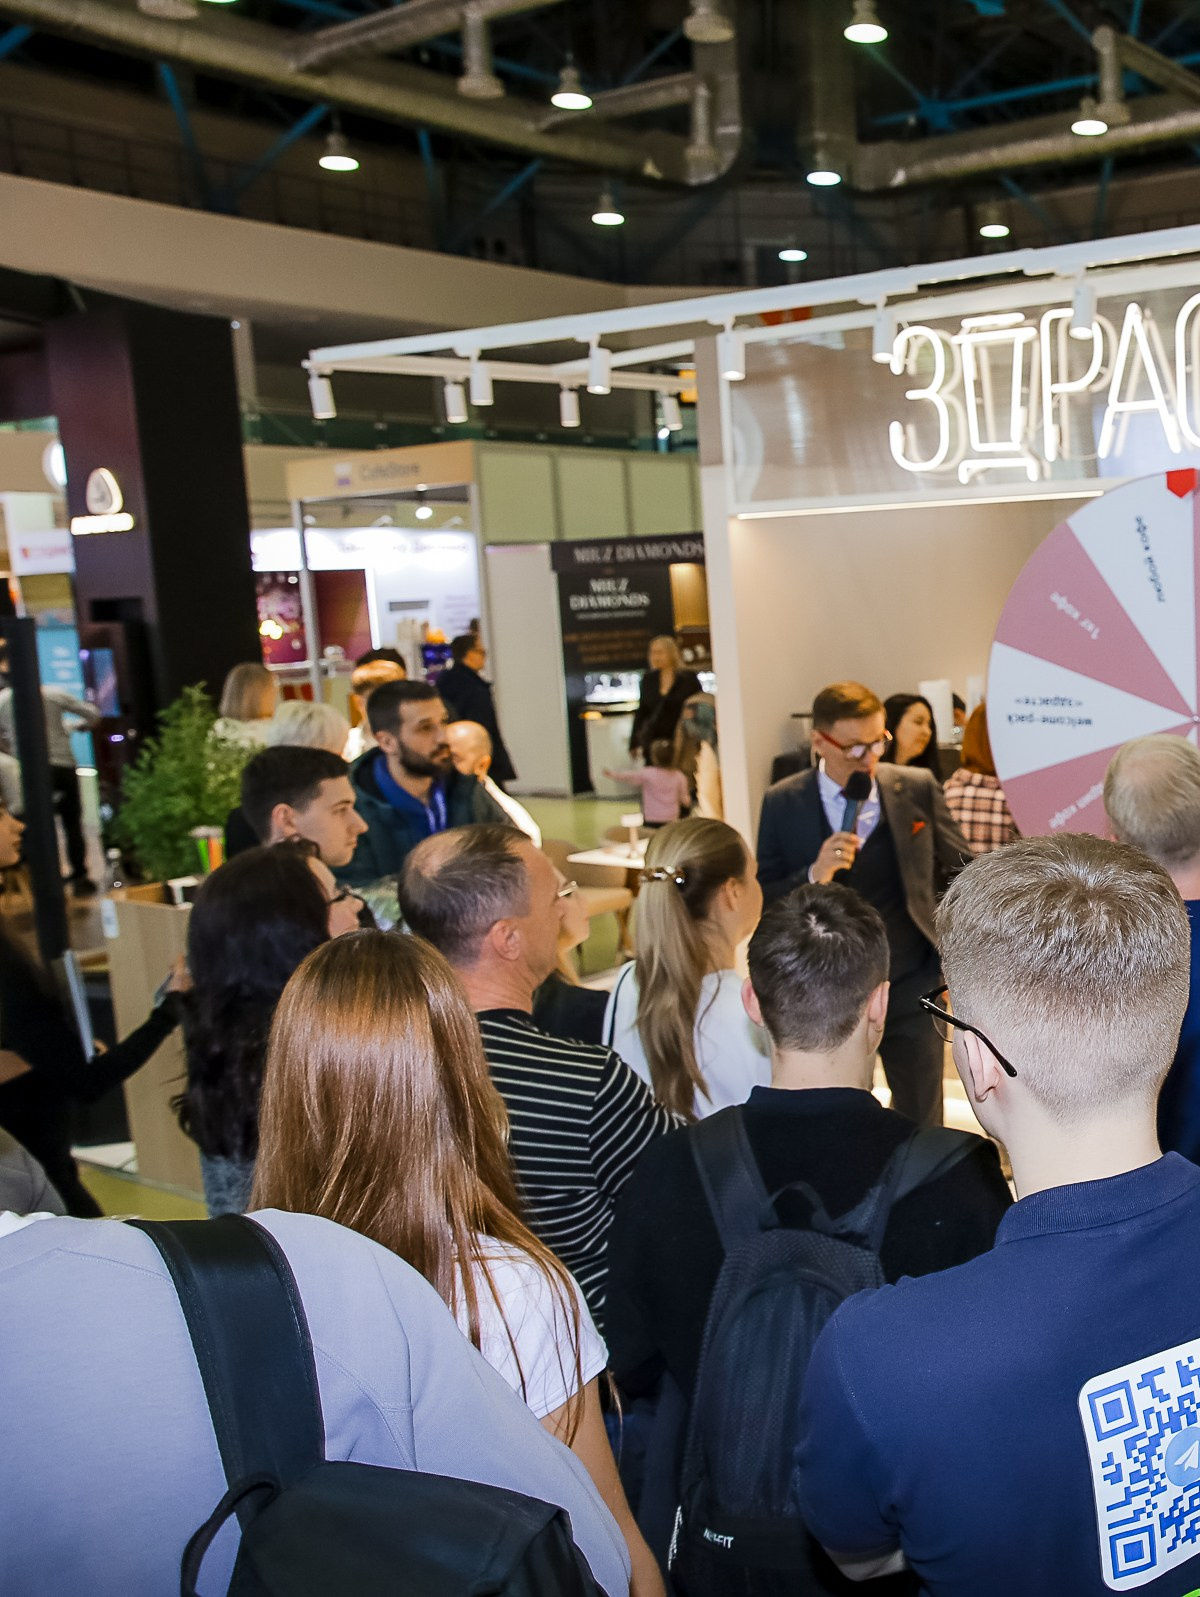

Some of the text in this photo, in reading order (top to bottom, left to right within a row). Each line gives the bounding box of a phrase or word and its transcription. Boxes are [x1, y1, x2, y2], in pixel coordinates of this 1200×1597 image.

[1134, 515, 1151, 551] кофе
[1050, 591, 1080, 621] кофе
[1048, 804, 1077, 829] кофе
